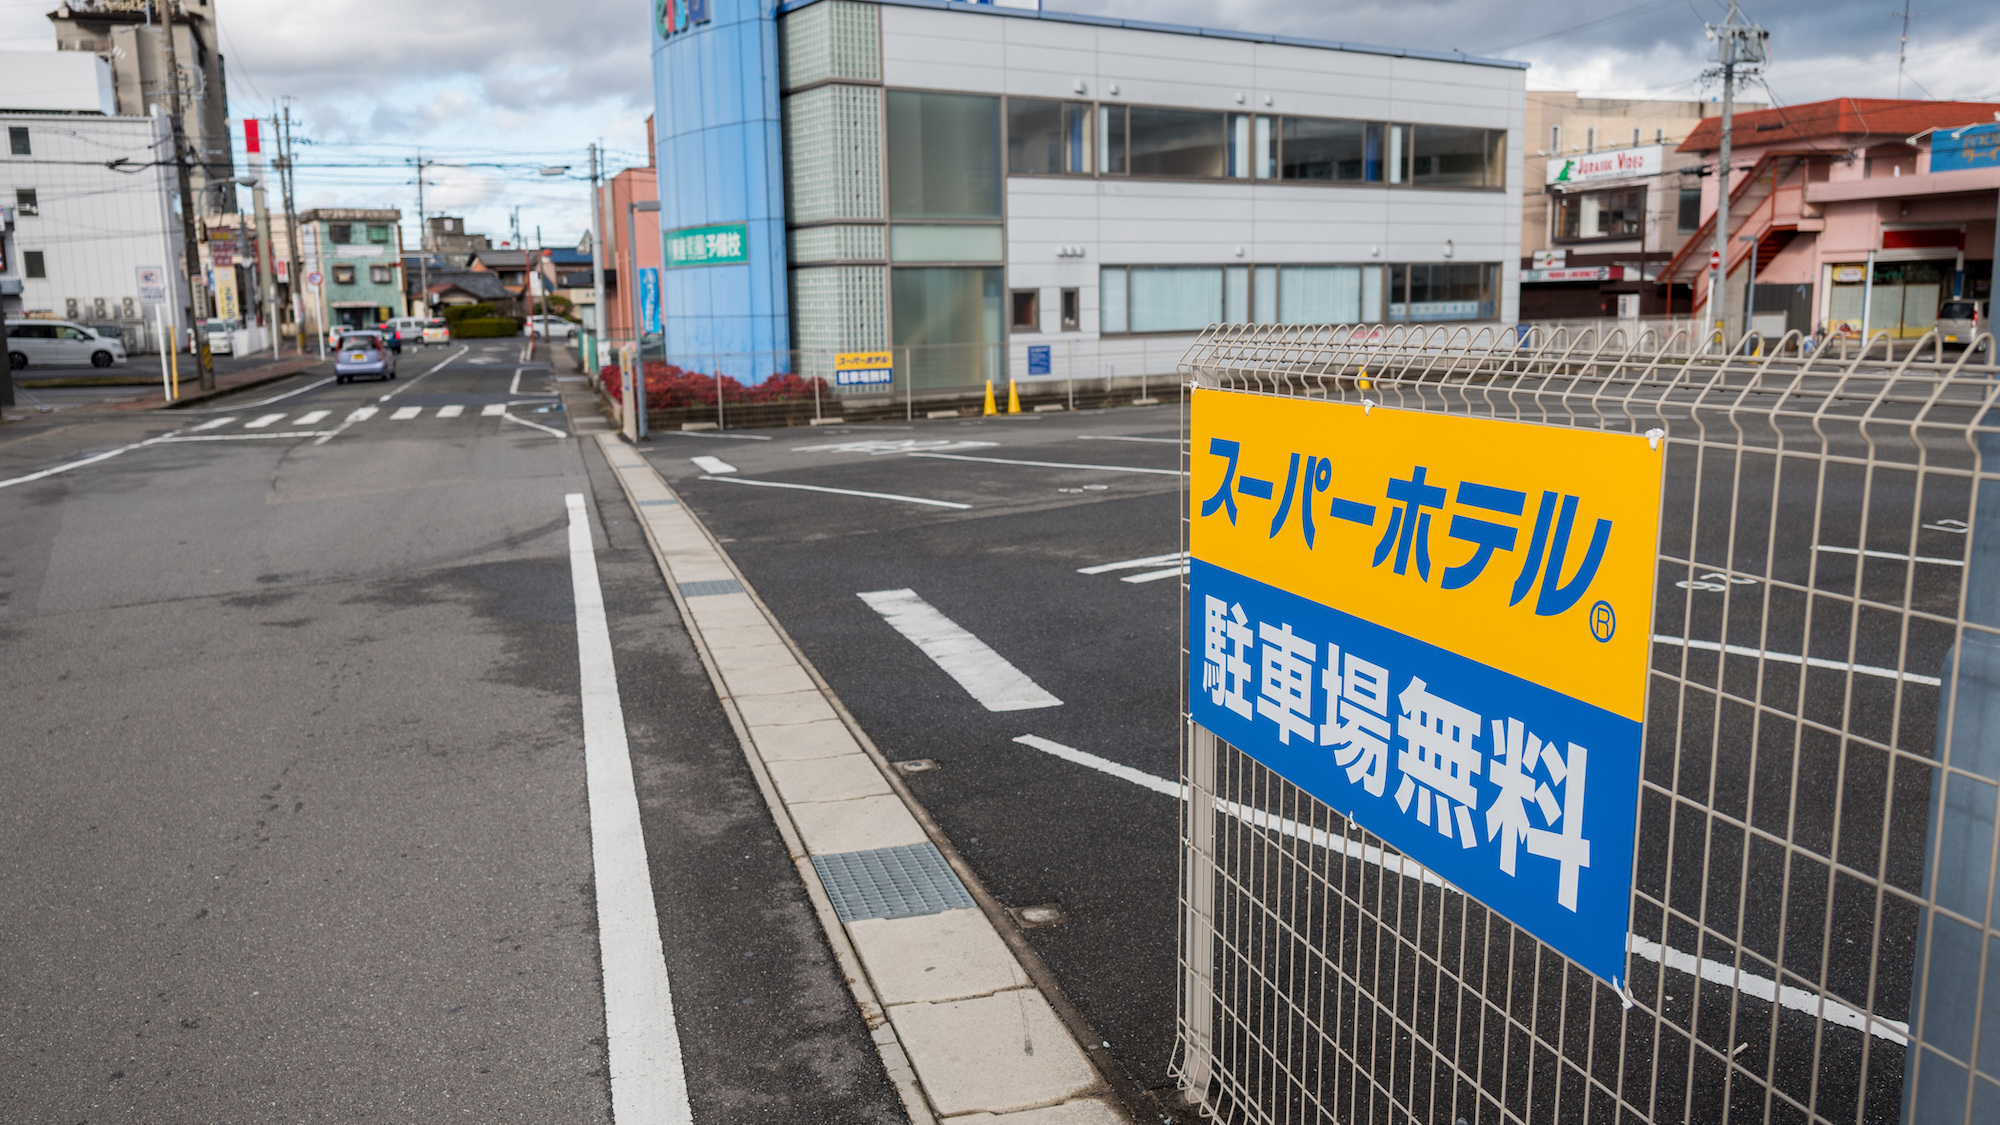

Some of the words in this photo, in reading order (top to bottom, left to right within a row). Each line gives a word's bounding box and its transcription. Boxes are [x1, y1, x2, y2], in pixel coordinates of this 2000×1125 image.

[838, 356, 889, 366] スーパーホテル
[1201, 438, 1613, 617] スーパーホテル
[1202, 594, 1591, 914] 駐車場無料
